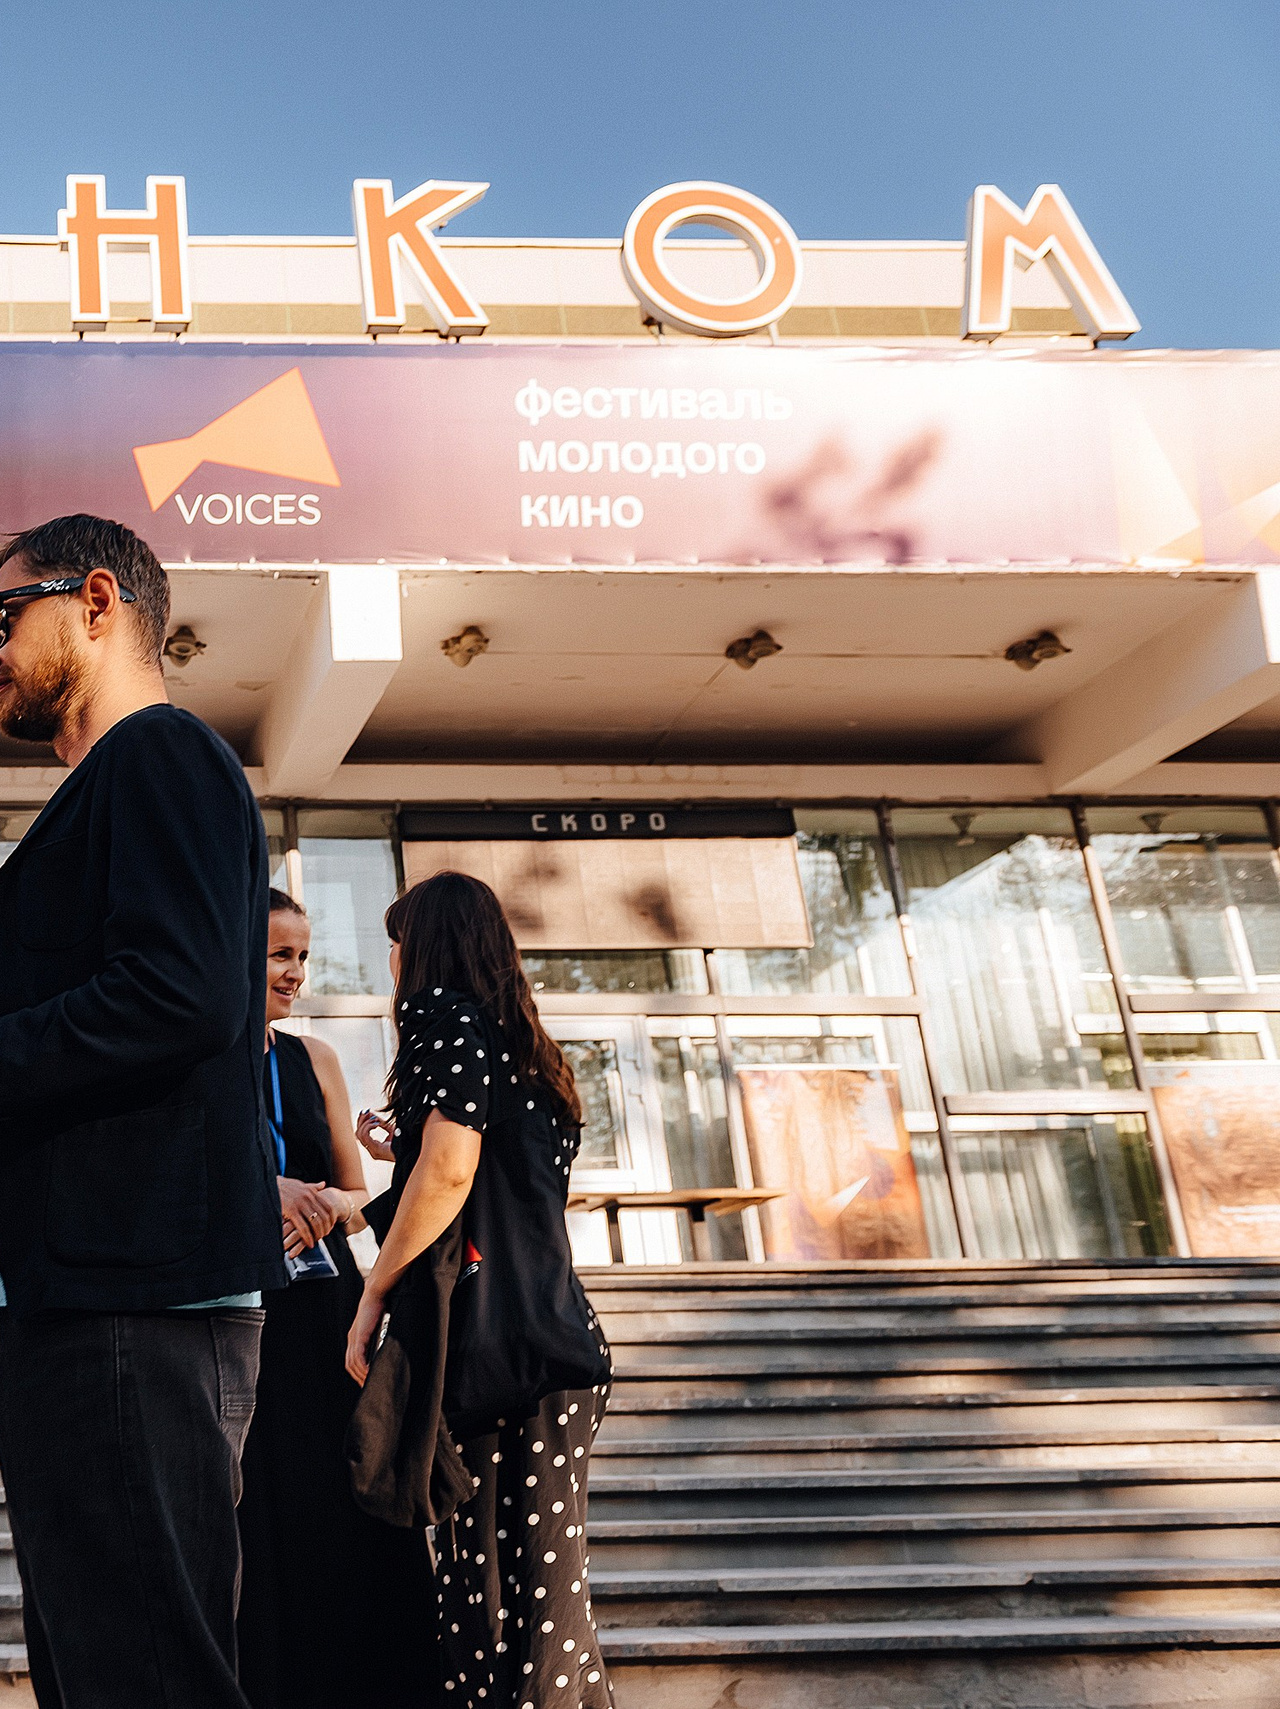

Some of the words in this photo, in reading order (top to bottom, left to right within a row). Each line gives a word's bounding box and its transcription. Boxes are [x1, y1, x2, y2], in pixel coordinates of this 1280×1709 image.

[514, 378, 794, 426] фестиваль
[518, 440, 767, 479] молодого
[174, 492, 322, 526] VOICES
[531, 813, 667, 832] СКОРО
